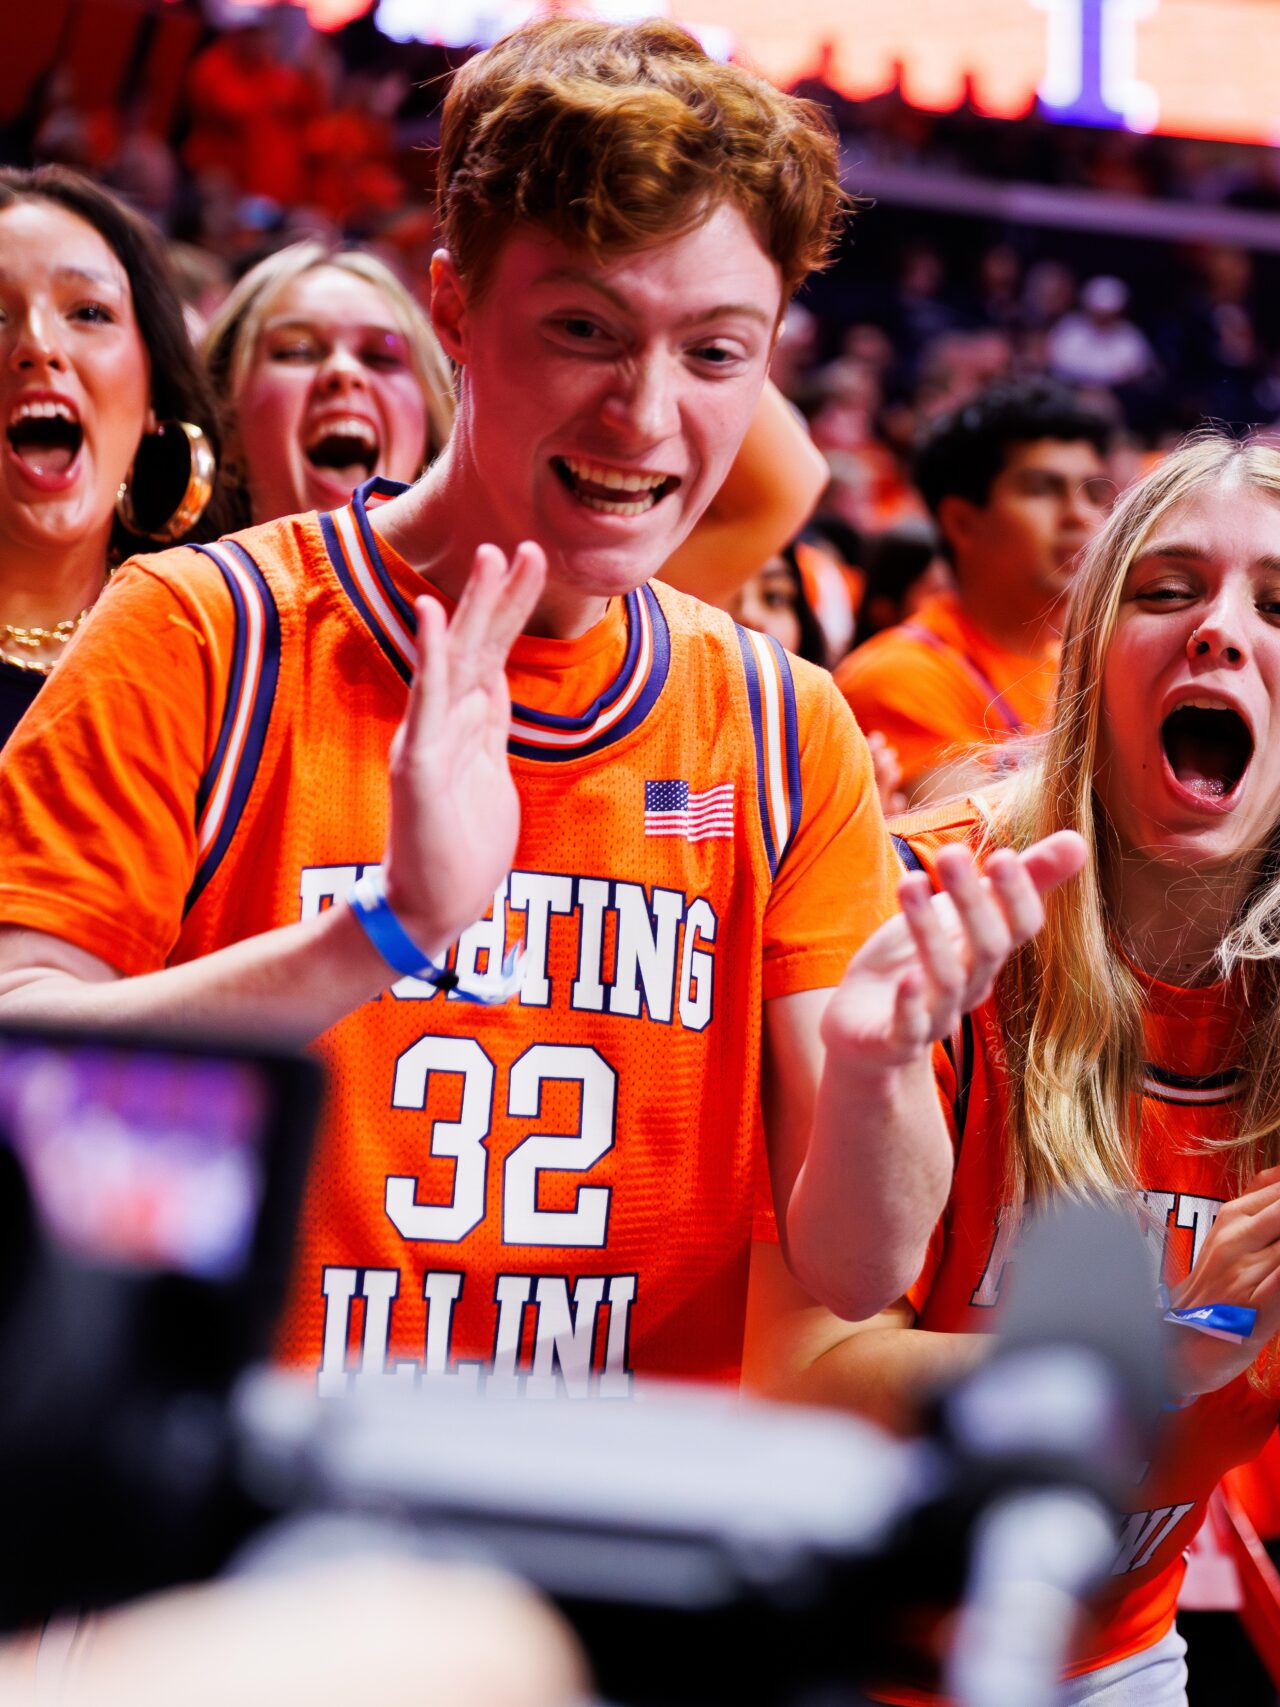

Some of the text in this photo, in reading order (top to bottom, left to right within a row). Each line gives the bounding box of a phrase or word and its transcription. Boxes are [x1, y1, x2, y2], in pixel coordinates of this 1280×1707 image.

[300, 862, 719, 1033] HTING
[384, 1034, 619, 1249] 32
[316, 1264, 640, 1400] ILLINI
